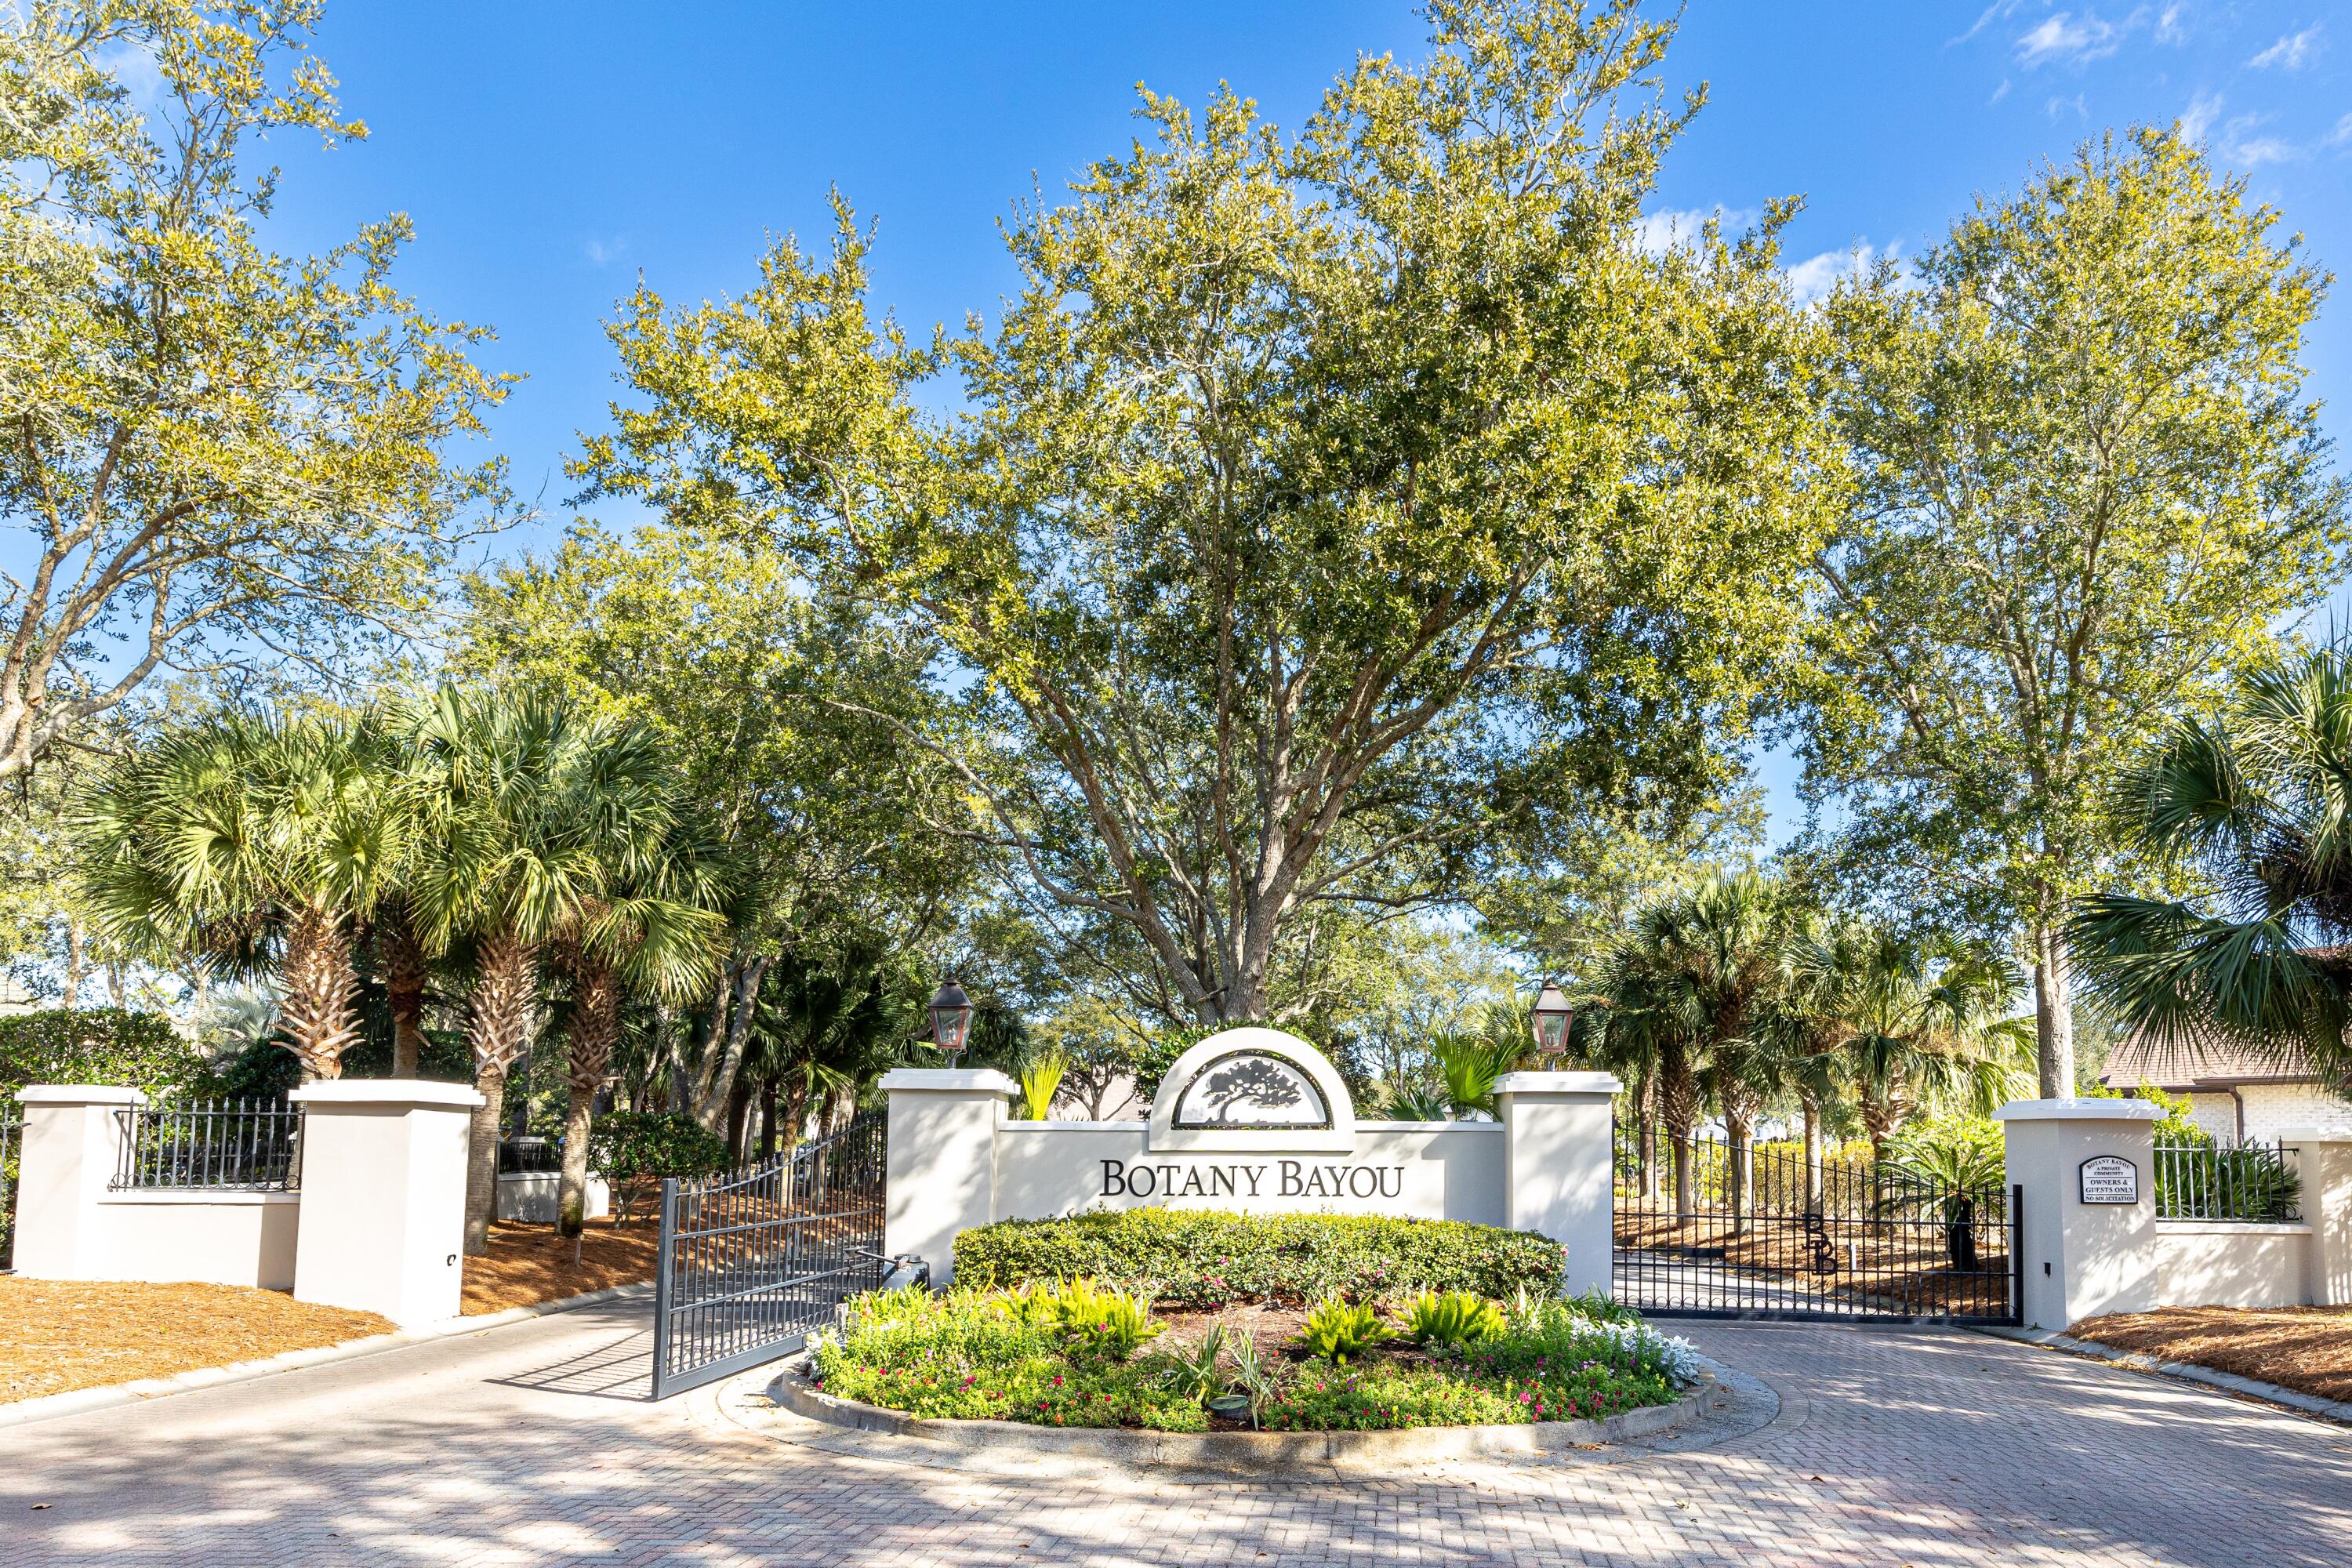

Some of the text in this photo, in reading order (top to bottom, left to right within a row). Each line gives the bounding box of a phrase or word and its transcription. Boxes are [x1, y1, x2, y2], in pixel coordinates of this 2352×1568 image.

[2087, 1159, 2131, 1170] BOTANY BAYOU
[1099, 1160, 1405, 1198] BOTANY BAYOU
